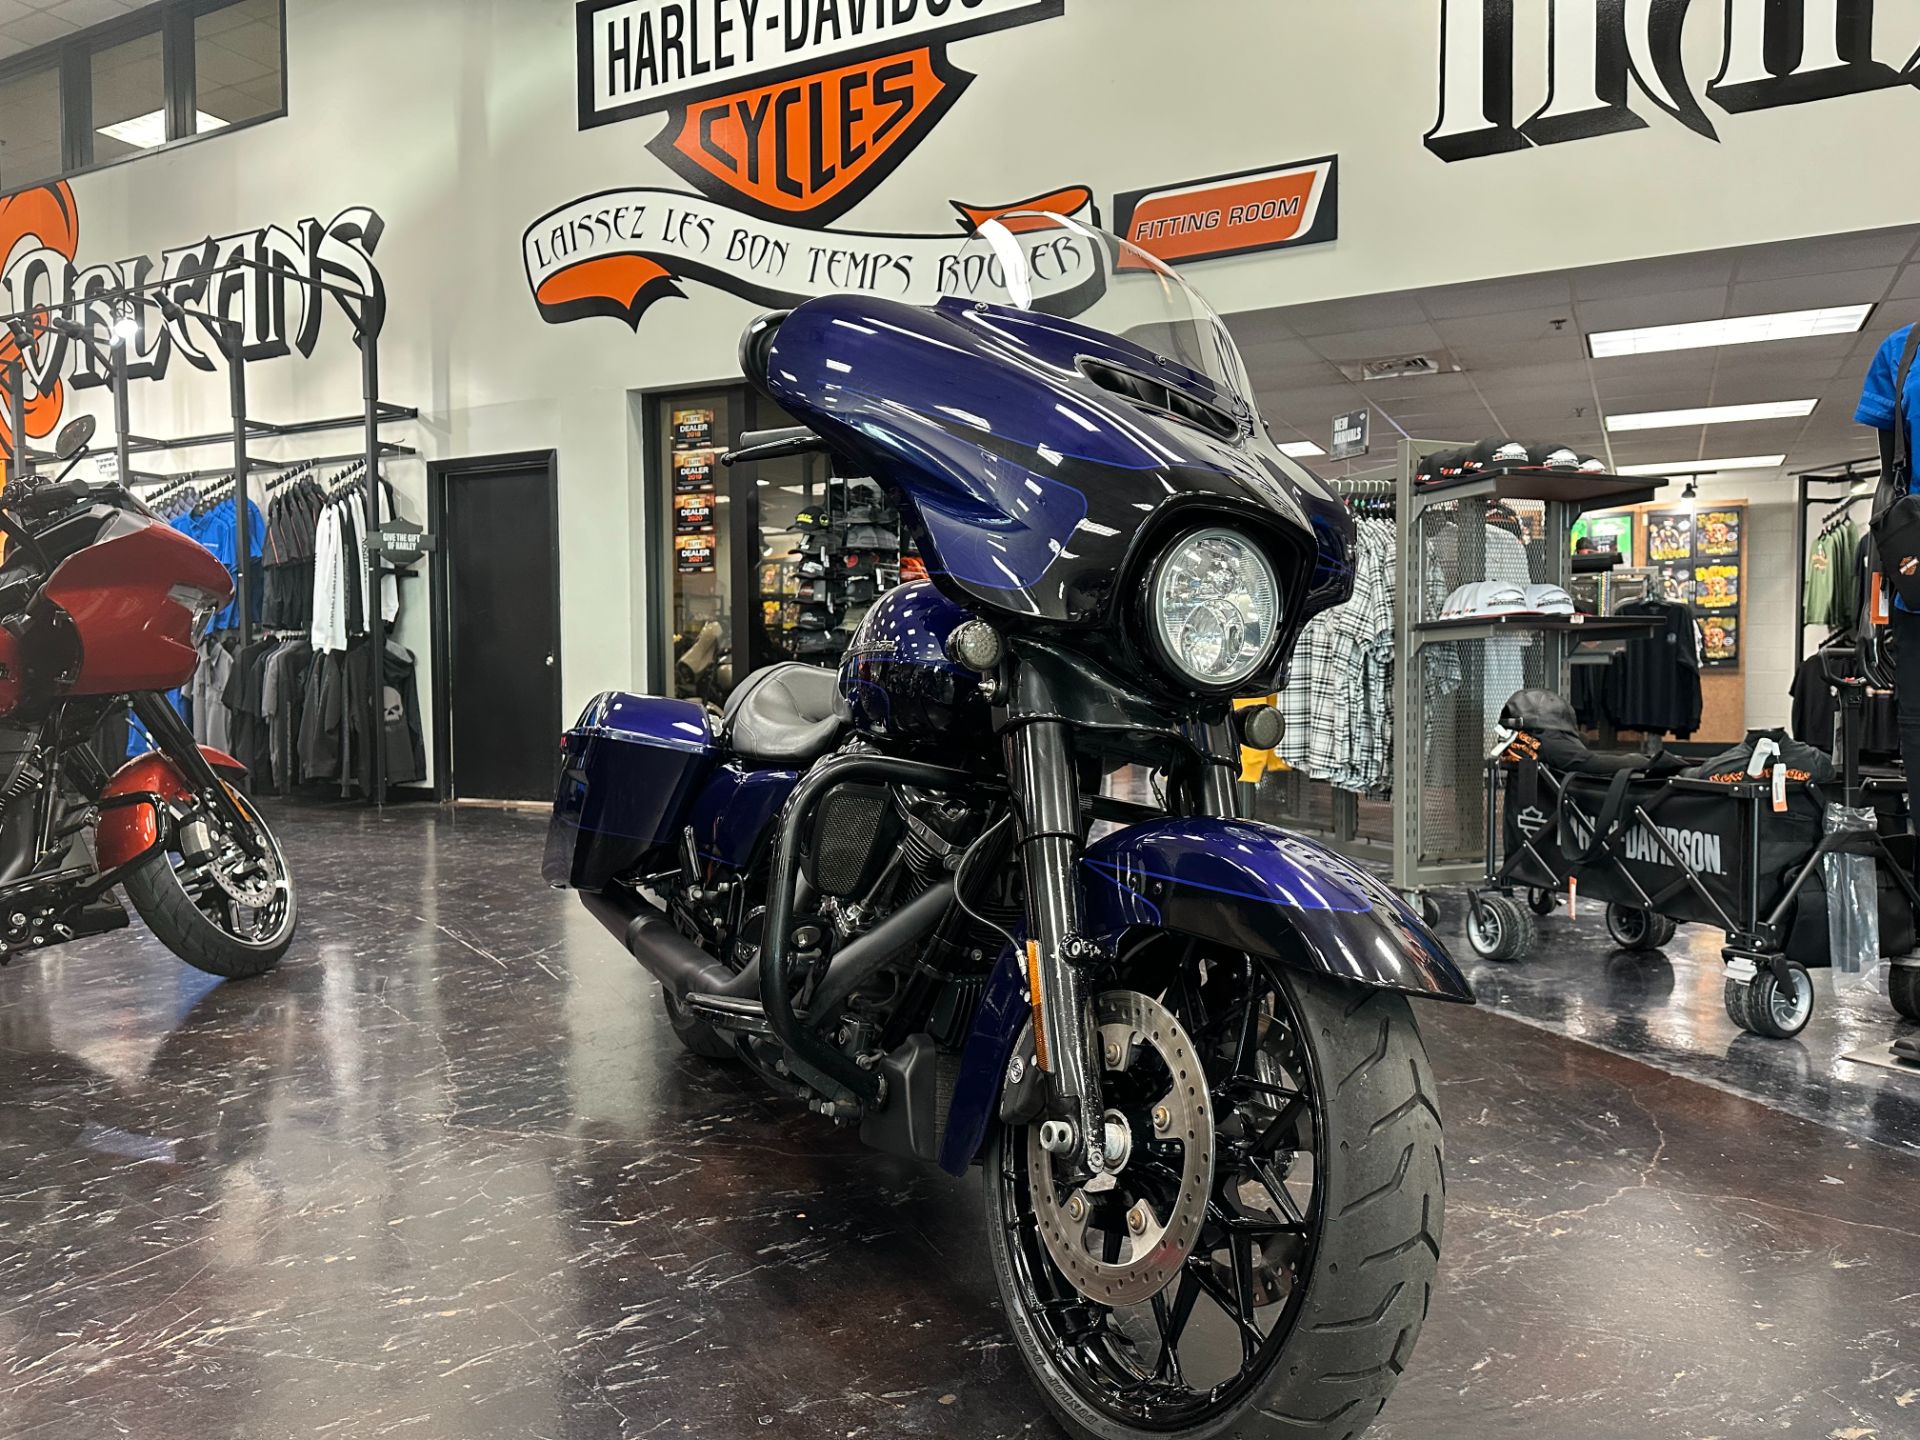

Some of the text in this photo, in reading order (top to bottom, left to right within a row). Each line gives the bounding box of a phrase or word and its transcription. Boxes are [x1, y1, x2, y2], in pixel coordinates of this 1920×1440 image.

[608, 0, 983, 97] HARLEY-DA
[699, 59, 914, 199] CYCLES
[1135, 195, 1300, 242] FITTING ROOM
[532, 205, 1081, 295] LAISSEZ LES BON TEMPS ROUER
[680, 423, 708, 432] DEALER
[1334, 416, 1349, 432] NEW
[1333, 427, 1362, 445] ARRIVALS
[680, 466, 709, 475] DEALER
[681, 508, 709, 516] DEALER
[383, 532, 420, 543] GIVE THE GIFT
[388, 541, 417, 550] OF HARLEY
[682, 549, 710, 557] DEALER
[1046, 1375, 1099, 1426] DUNLOP
